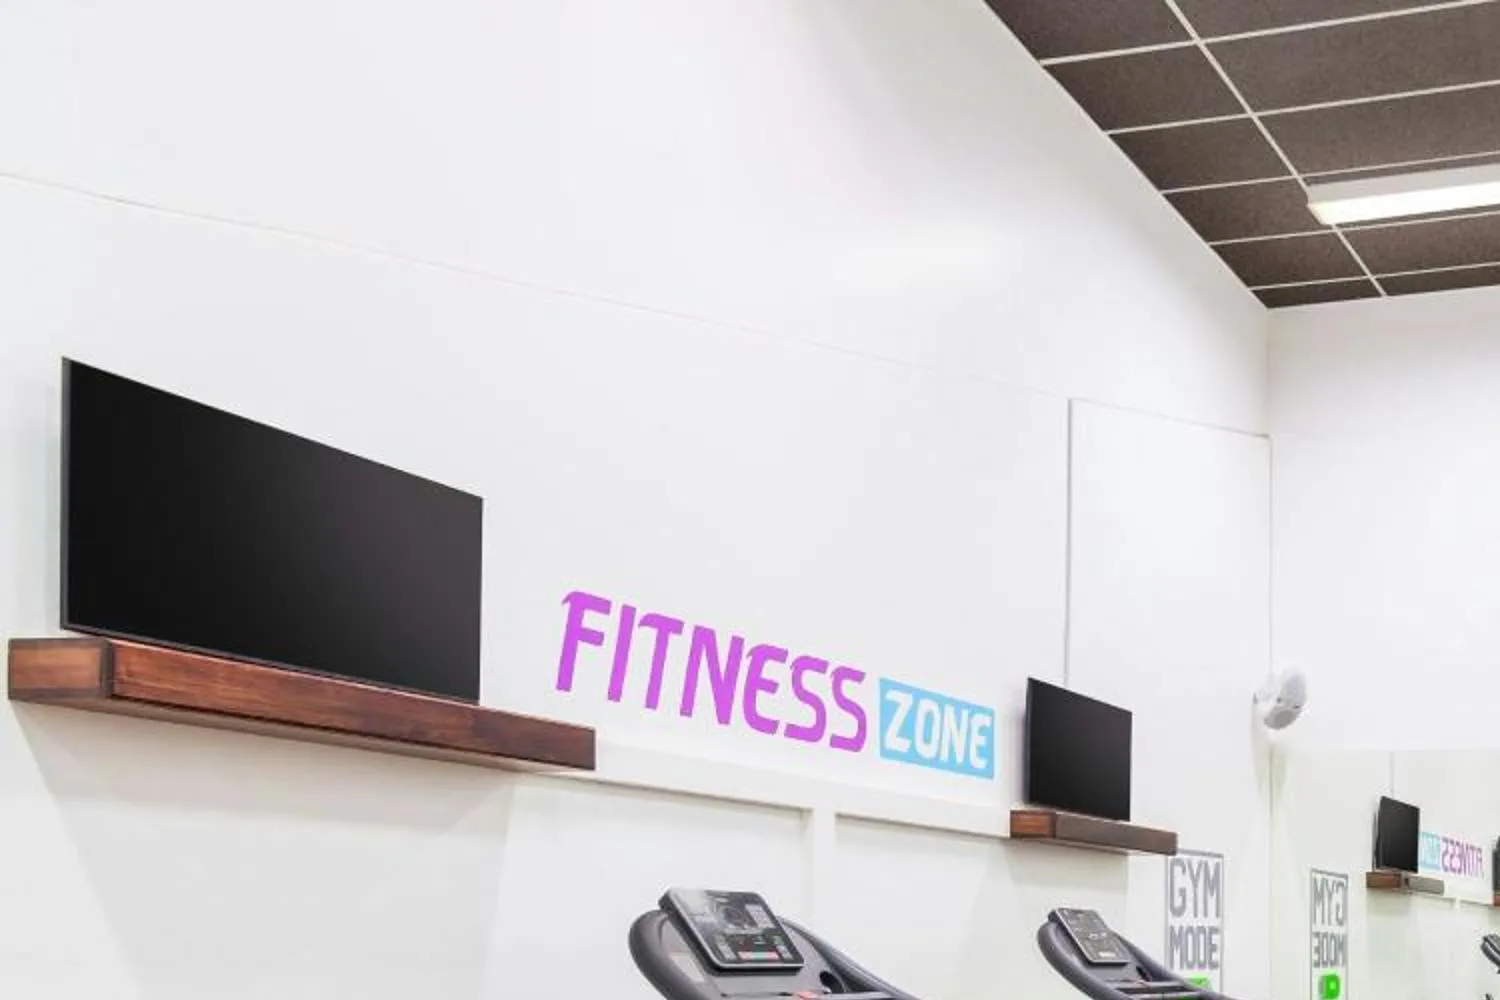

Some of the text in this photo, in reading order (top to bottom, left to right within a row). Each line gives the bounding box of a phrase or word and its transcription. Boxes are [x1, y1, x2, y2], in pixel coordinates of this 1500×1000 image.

[555, 591, 991, 769] FITNESS ZONE
[1169, 857, 1220, 919] GYM
[1169, 925, 1220, 971] MODE
